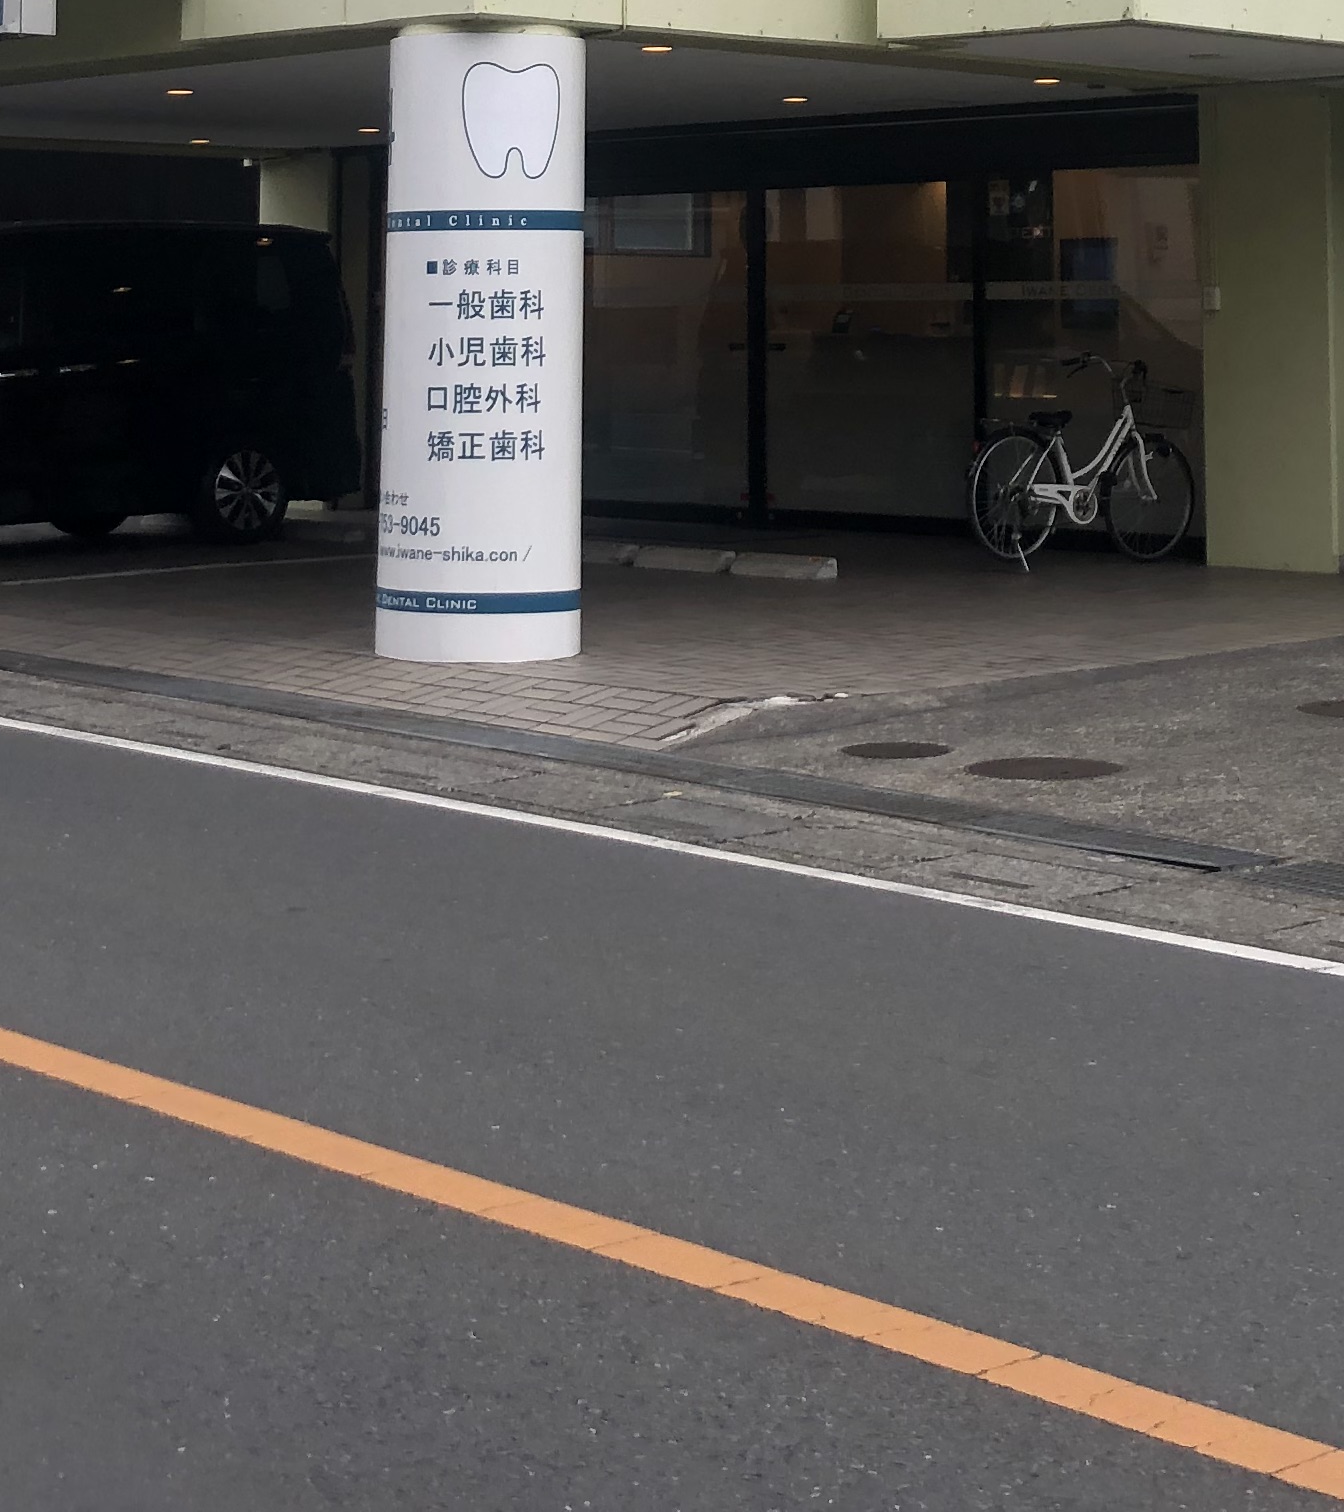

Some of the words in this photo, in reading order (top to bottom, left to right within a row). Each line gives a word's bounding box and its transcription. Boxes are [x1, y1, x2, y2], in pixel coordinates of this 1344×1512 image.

[448, 214, 528, 227] Clinic
[428, 288, 545, 320] 一般歯科
[428, 335, 546, 368] 小児歯科
[427, 383, 542, 414] 口腔外科
[427, 429, 546, 462] 矯正歯科
